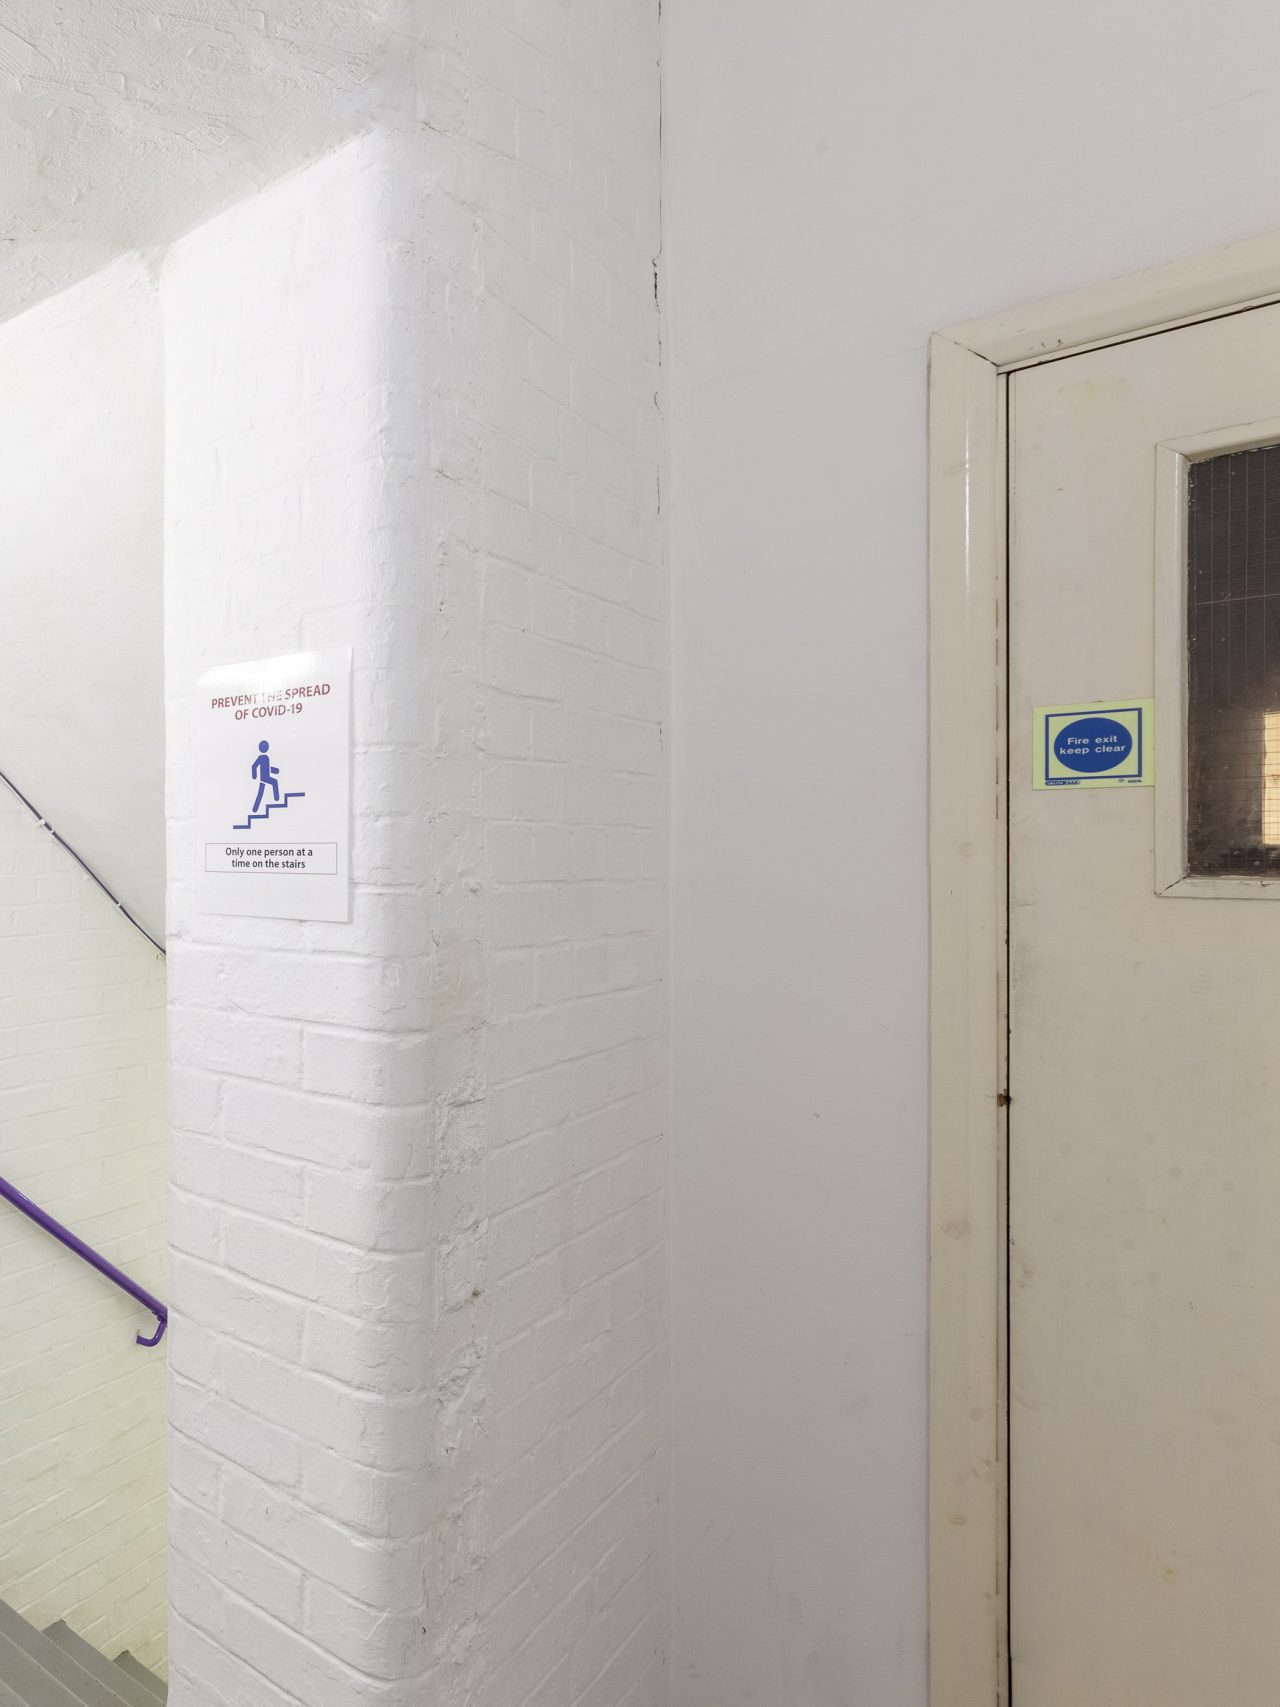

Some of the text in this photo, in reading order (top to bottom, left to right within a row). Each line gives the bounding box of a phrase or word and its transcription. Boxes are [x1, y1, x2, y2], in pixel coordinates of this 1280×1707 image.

[211, 693, 259, 709] PREVENT
[285, 683, 331, 700] SPREAD
[234, 709, 249, 720] OF
[1067, 735, 1118, 745] Fire exit
[1059, 744, 1126, 755] keep clear
[225, 847, 245, 858] Only
[264, 848, 294, 858] person
[296, 848, 306, 856] at
[231, 859, 306, 869] time on the stairs
